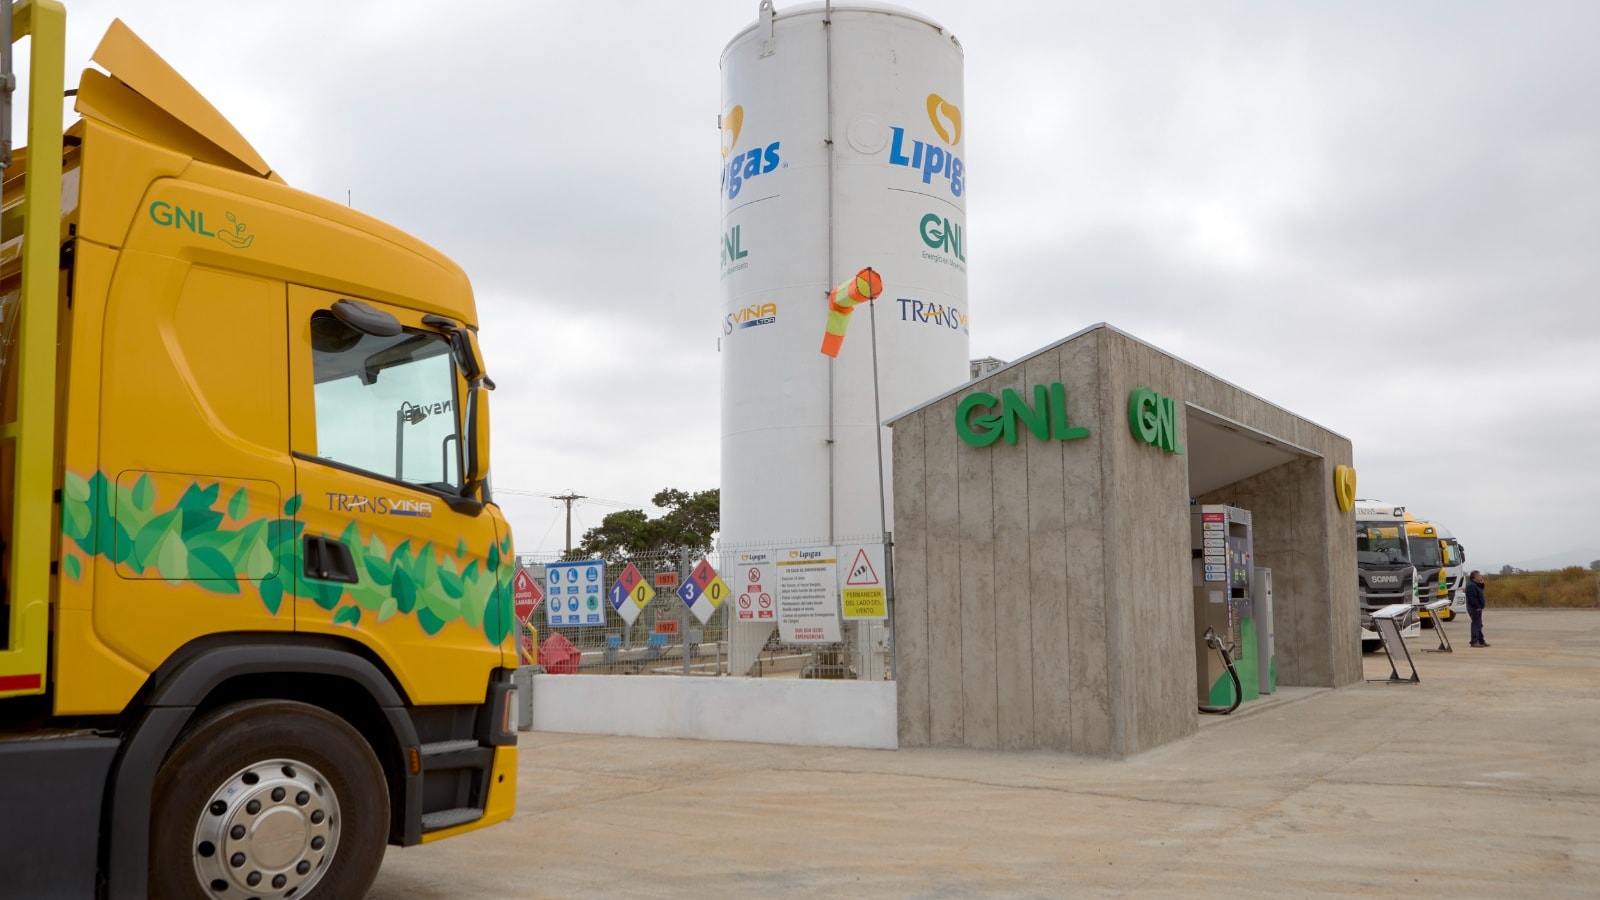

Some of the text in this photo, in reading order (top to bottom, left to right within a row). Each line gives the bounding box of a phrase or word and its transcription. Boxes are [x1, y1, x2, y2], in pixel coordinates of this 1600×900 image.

[889, 126, 965, 197] Lipig
[150, 201, 215, 237] GNL
[721, 224, 748, 268] NL
[920, 213, 965, 263] GNL
[955, 382, 1090, 447] GNL
[1128, 386, 1185, 455] GNL
[799, 551, 821, 559] Lipigas
[625, 571, 633, 585] 4
[659, 575, 674, 584] 1971
[698, 566, 707, 582] 4
[1371, 575, 1398, 583] SCANIA
[613, 586, 620, 603] 1
[637, 586, 645, 602] 0
[685, 583, 694, 600] 3
[711, 583, 720, 600] 0
[659, 623, 674, 632] 1972
